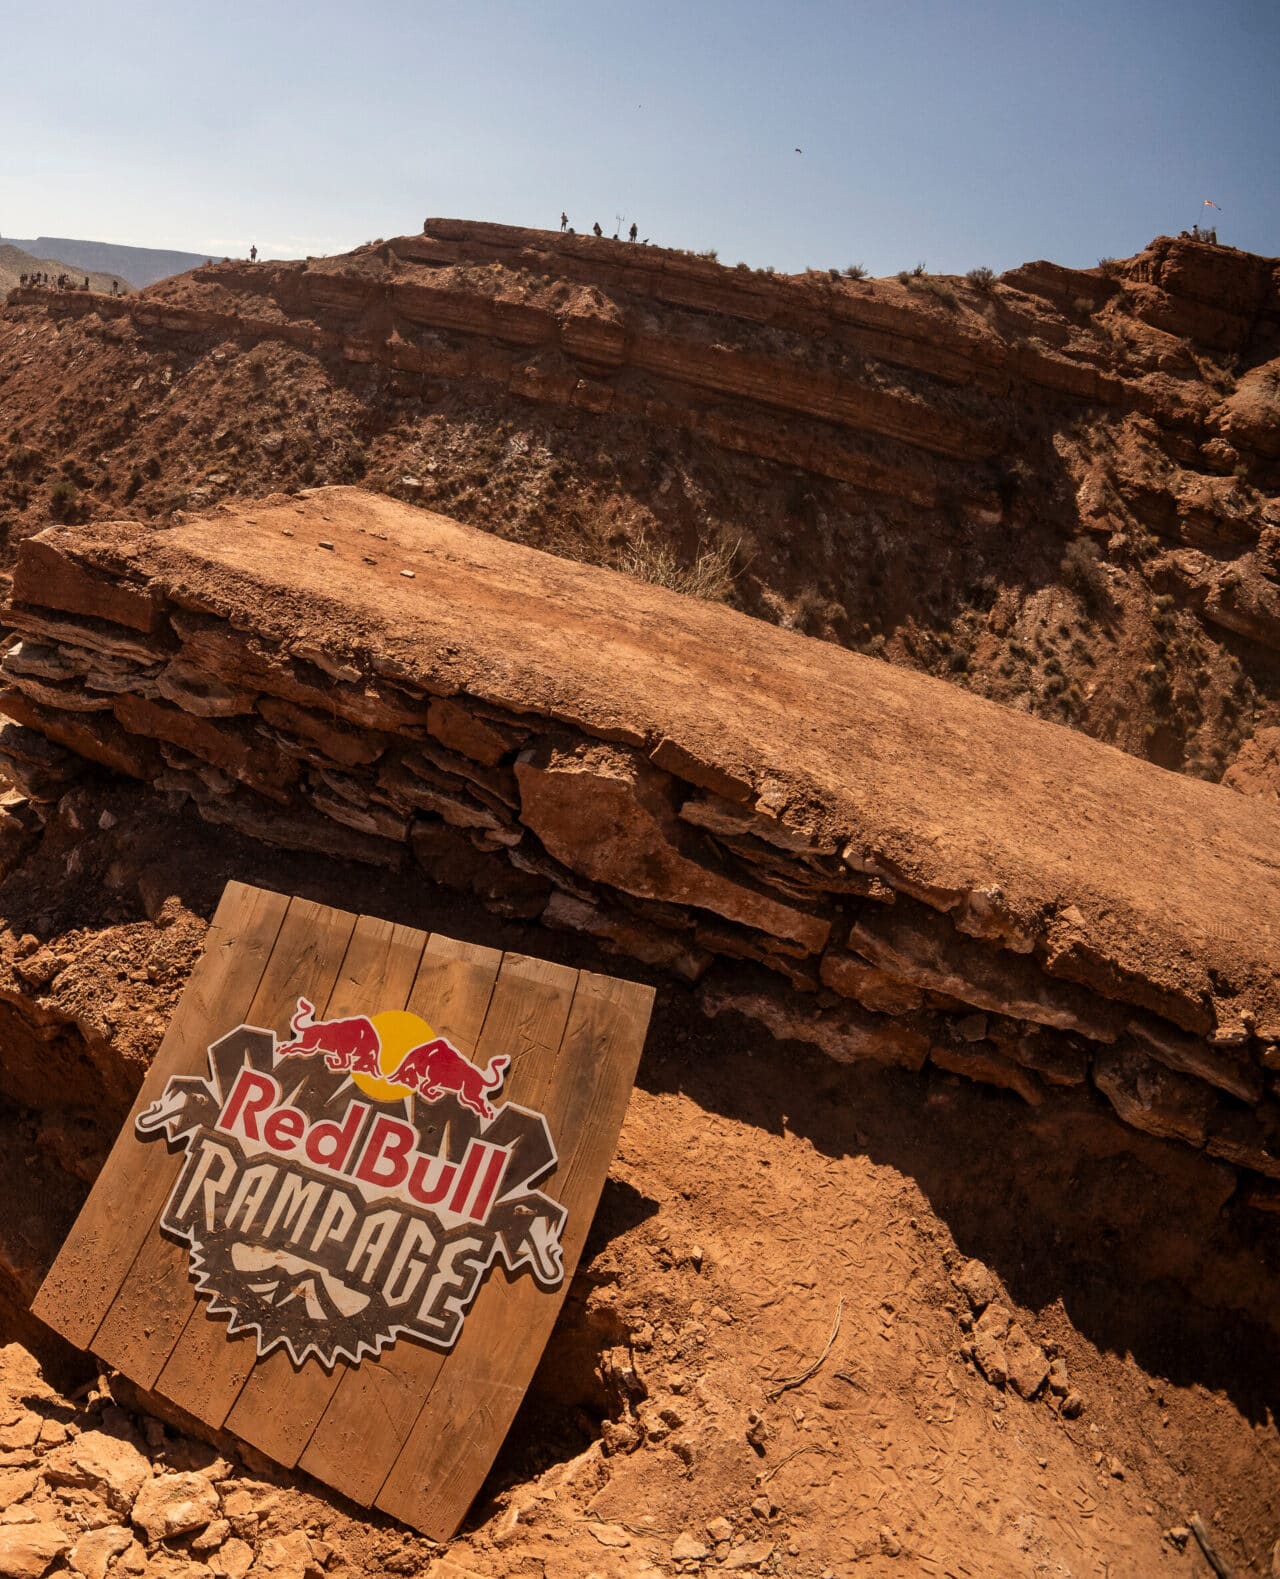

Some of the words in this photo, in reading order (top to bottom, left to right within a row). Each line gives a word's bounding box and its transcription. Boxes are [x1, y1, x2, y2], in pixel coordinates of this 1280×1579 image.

[220, 1070, 365, 1171] Red
[355, 1117, 507, 1221] Bull
[175, 1141, 484, 1327] RAMPAGE
